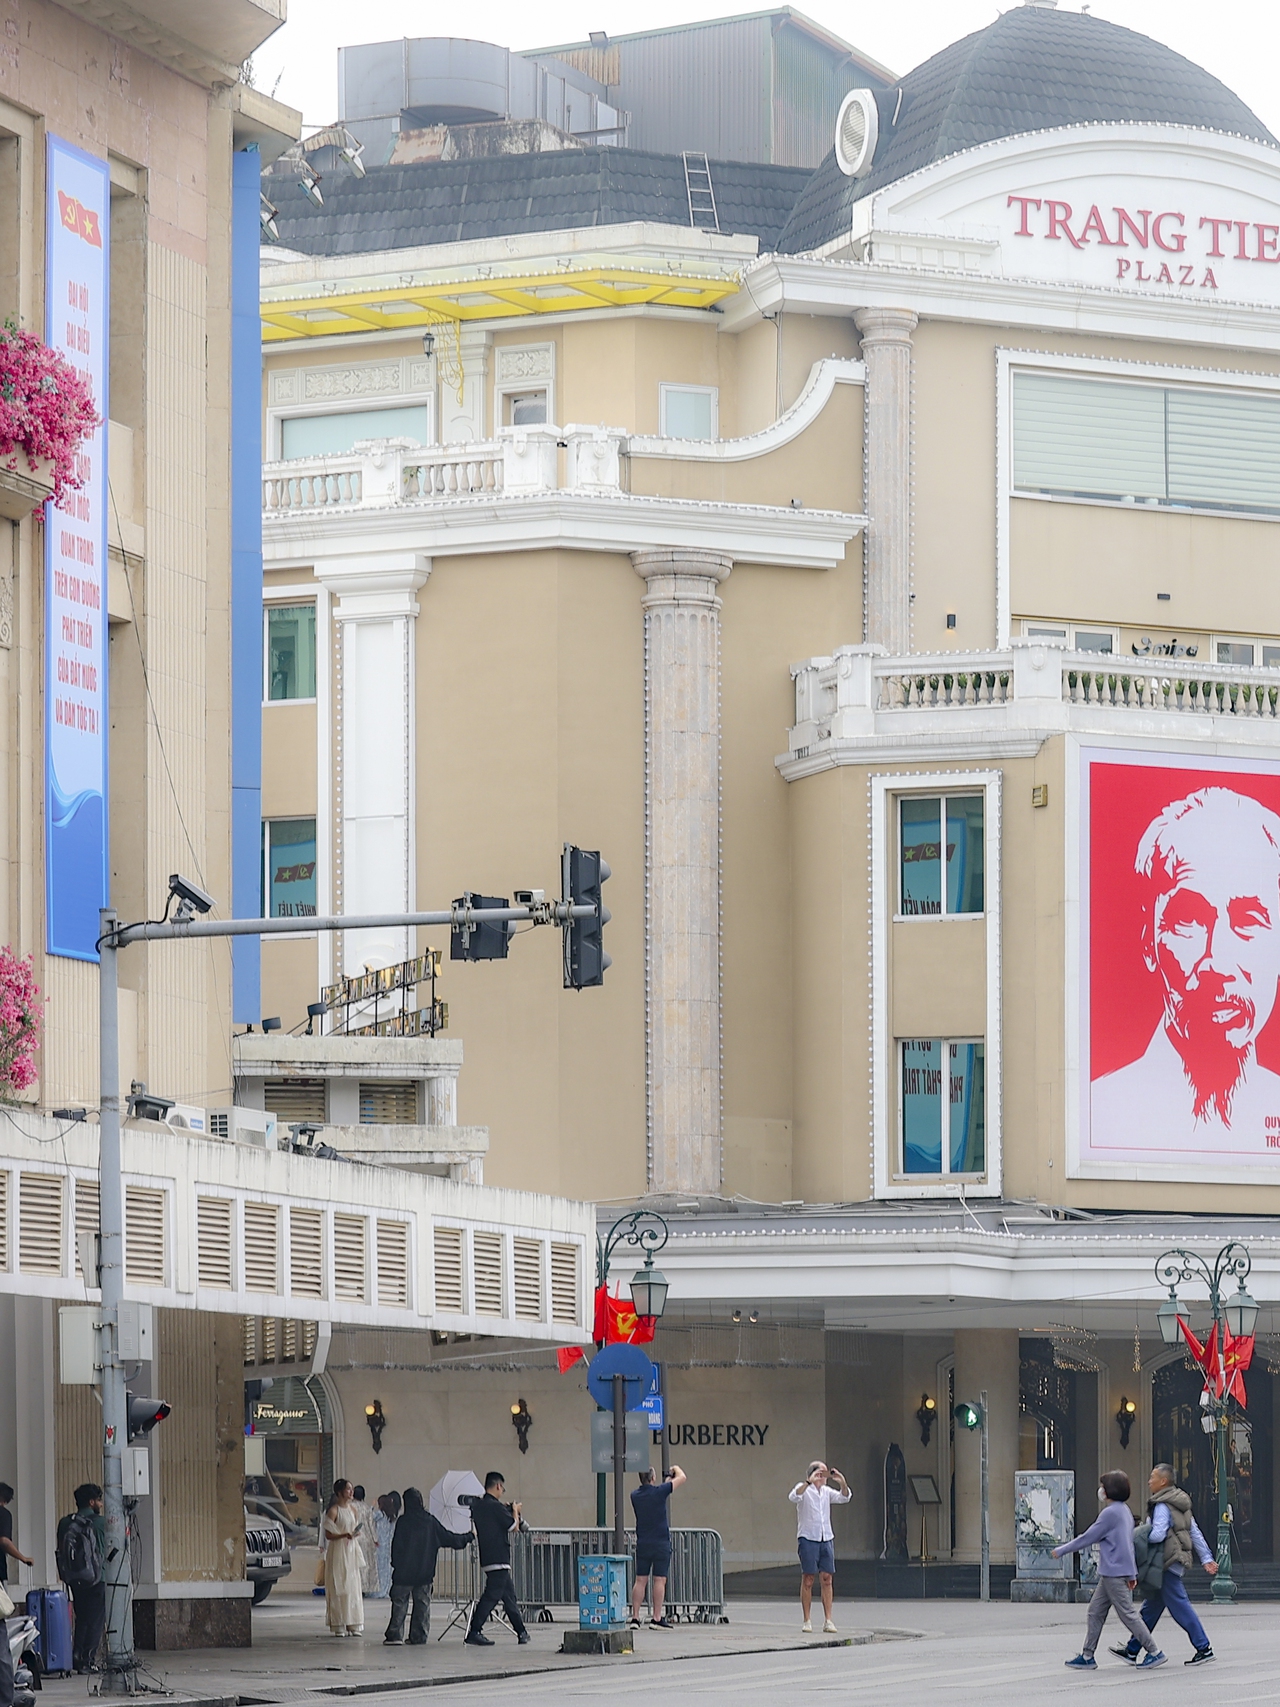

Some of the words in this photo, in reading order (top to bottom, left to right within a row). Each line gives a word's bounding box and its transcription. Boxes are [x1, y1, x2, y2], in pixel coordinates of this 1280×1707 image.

[1007, 195, 1187, 252] TRANG
[1116, 258, 1218, 288] PLAZA
[60, 530, 75, 560] QUAN
[54, 567, 68, 599] TRÊN
[69, 575, 80, 602] CON
[81, 577, 100, 610] ĐƯỜNG
[62, 613, 76, 645] PHÁT
[77, 612, 93, 649] TRIỂN
[1152, 639, 1198, 658] mipa
[57, 651, 69, 684] CỦA
[64, 696, 76, 728] DÂN
[77, 701, 88, 735] TỘC
[253, 1404, 308, 1426] Ferragamo
[653, 1424, 769, 1446] BURBERRY
